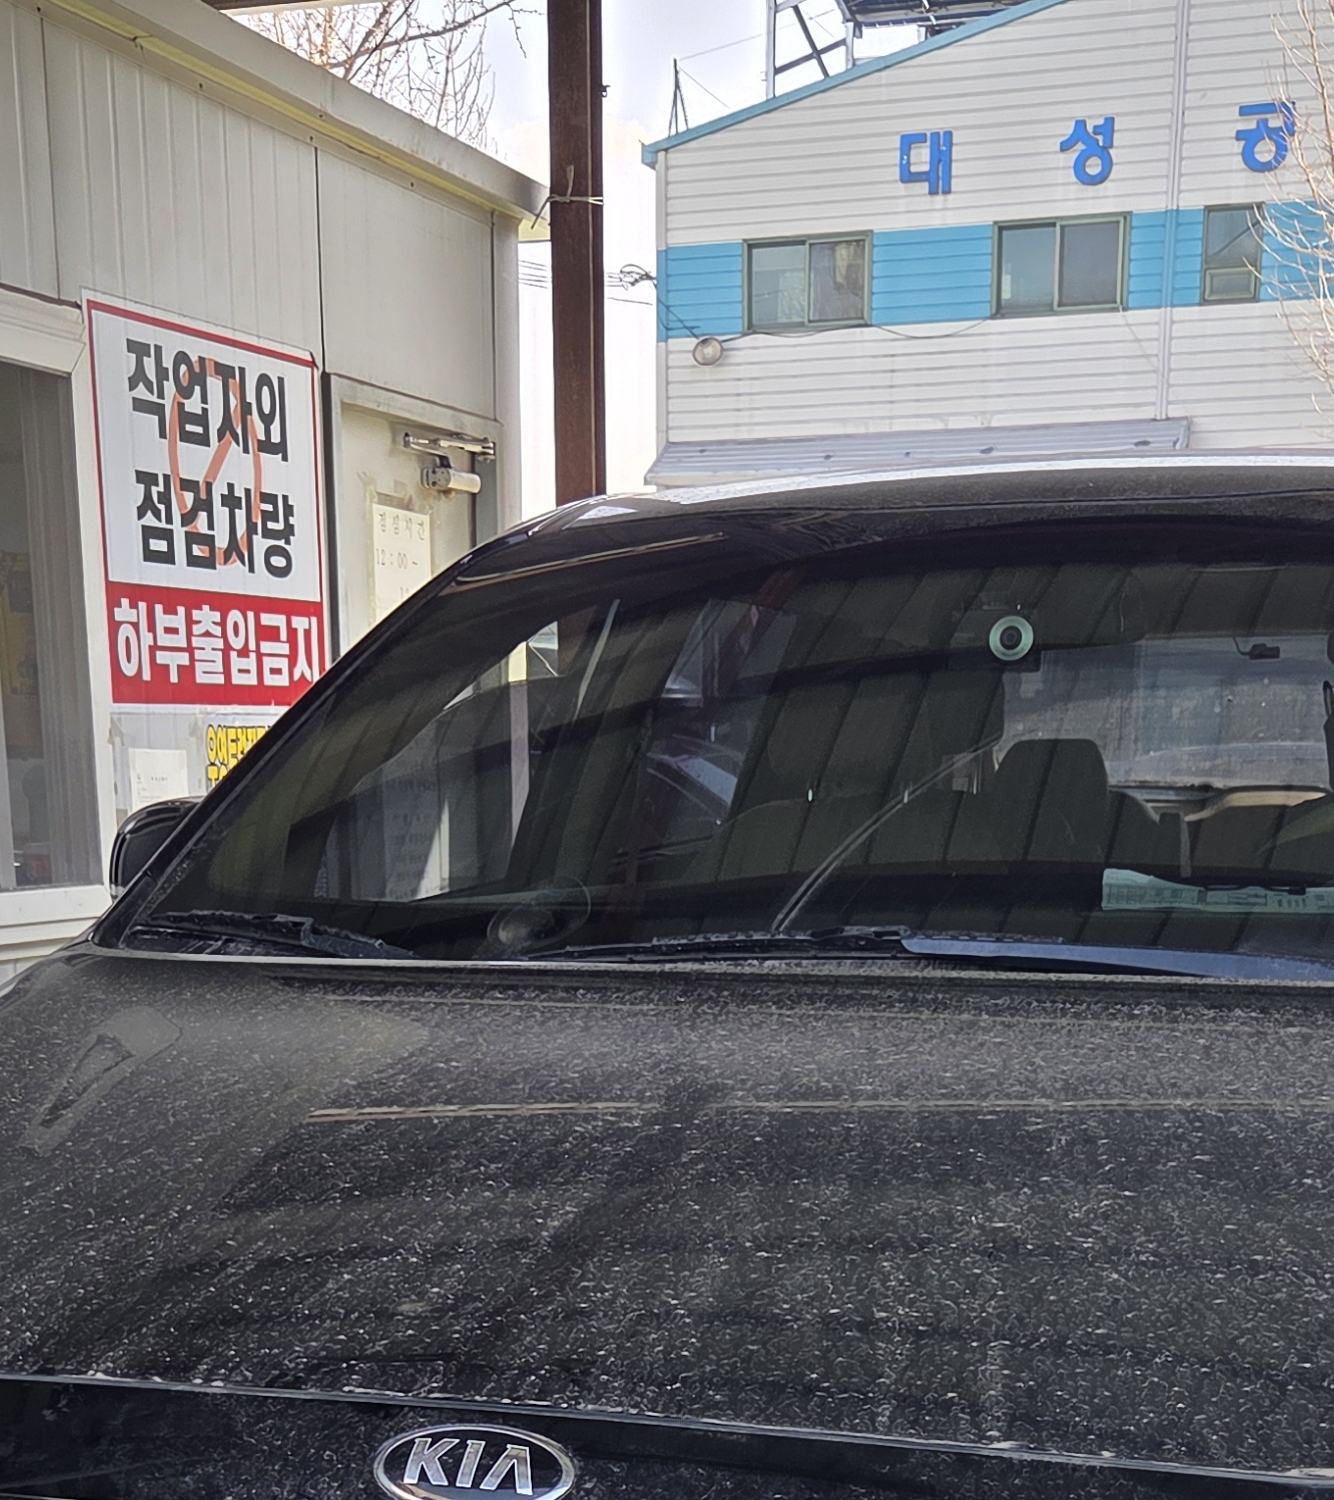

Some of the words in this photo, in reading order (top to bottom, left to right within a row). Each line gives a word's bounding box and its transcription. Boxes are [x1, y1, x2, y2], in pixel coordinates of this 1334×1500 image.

[125, 337, 290, 464] 작업자외
[134, 468, 296, 580] 점검차량
[112, 596, 319, 688] 하부출입금지
[403, 1437, 534, 1496] KIA
